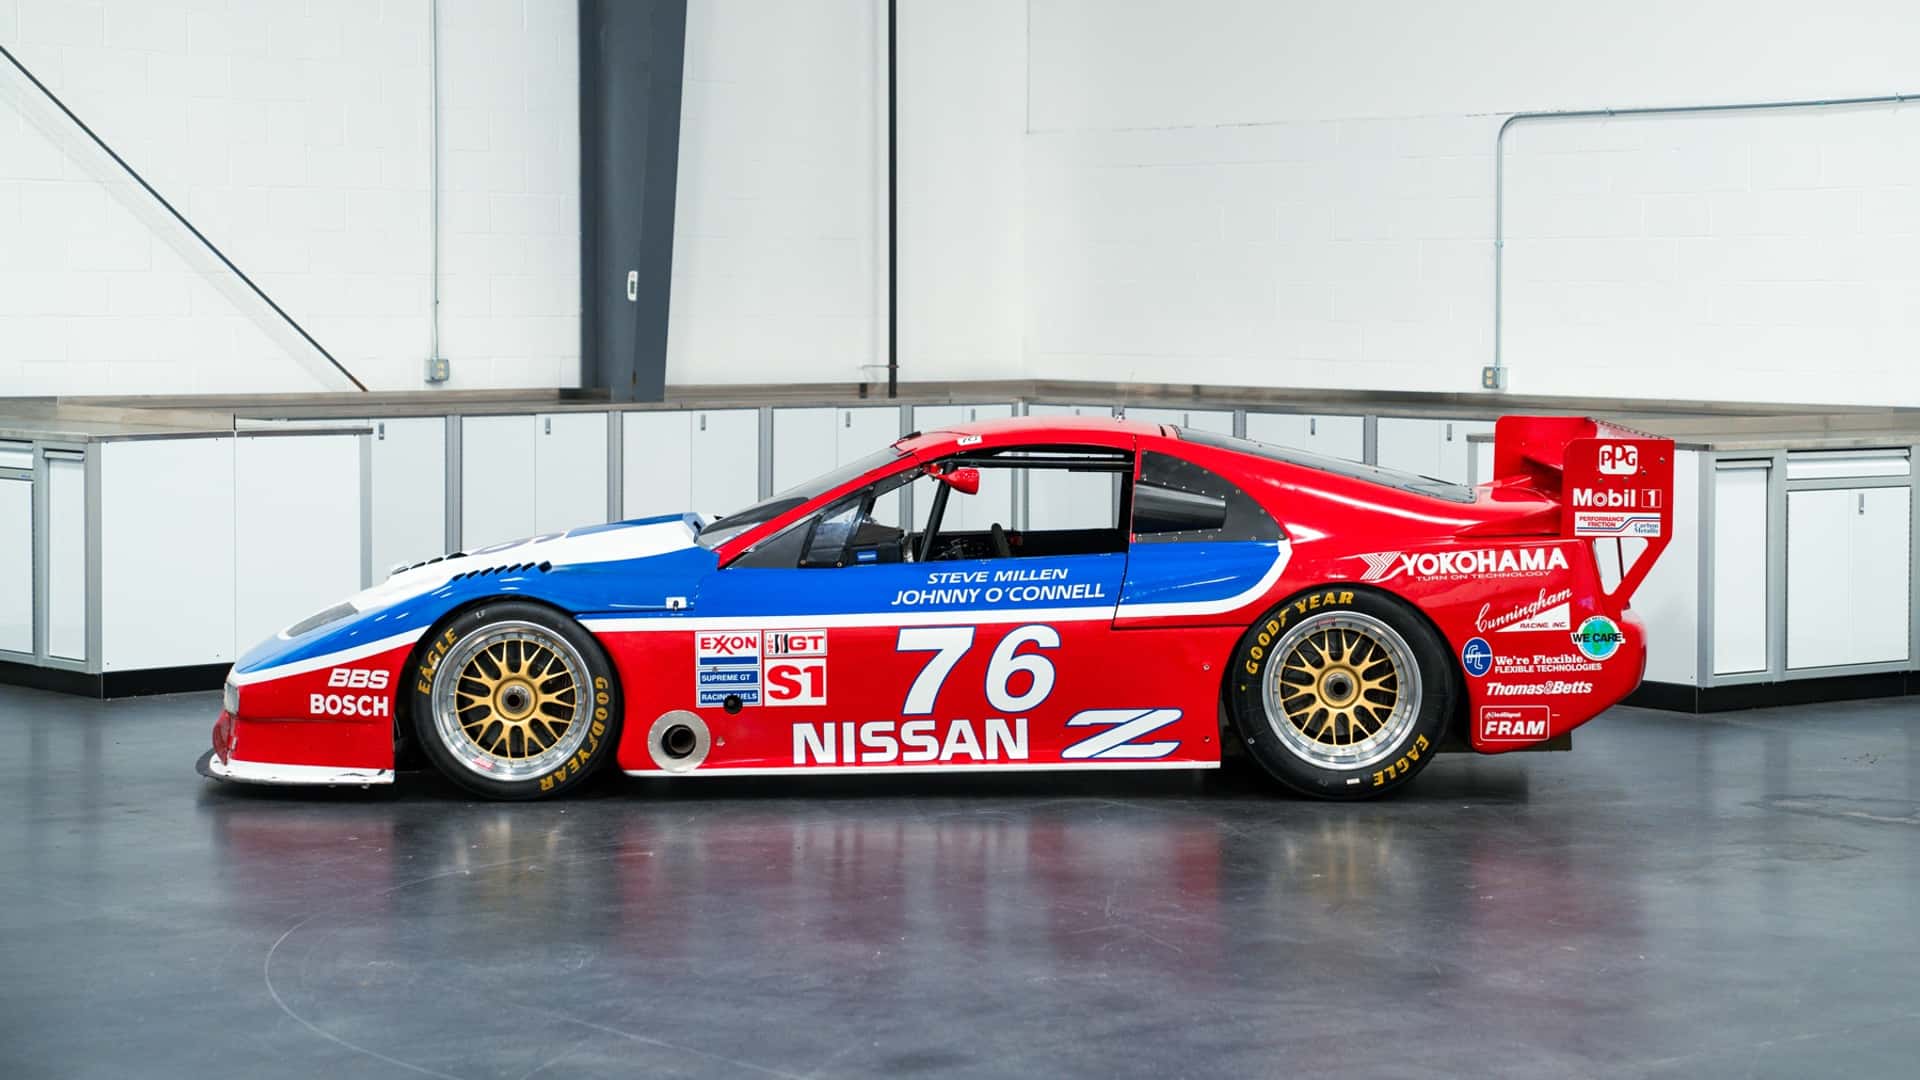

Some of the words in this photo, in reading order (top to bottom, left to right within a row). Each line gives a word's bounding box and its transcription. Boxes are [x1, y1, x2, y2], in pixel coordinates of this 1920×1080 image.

[1600, 446, 1636, 469] PPG
[1572, 488, 1636, 507] Mobil
[1647, 490, 1656, 507] 1
[1400, 547, 1569, 576] YOKOHAMA
[928, 571, 989, 585] STEVE
[994, 568, 1068, 582] MILLEN
[1471, 570, 1551, 579] TECHNOLOGY
[891, 588, 980, 606] JOHNNY
[985, 583, 1105, 603] O'CONNELL
[1475, 588, 1573, 633] Cunningham
[700, 635, 757, 655] EXXON
[788, 635, 825, 651] GT
[1572, 633, 1592, 643] WE
[417, 627, 458, 695] EAGLE
[896, 624, 1062, 716] 76
[1494, 665, 1534, 674] FLEXIBLE
[1537, 663, 1602, 673] TECHNOLOGIES
[1495, 655, 1529, 666] We're
[328, 668, 390, 690] BBS
[702, 673, 737, 682] SUPREME
[739, 673, 751, 681] GT
[767, 665, 824, 699] S1
[1486, 680, 1593, 696] Thomas&Betts
[310, 694, 389, 717] BOSCH
[1485, 720, 1545, 735] FRAM
[793, 718, 1029, 764] NISSAN
[1372, 734, 1430, 787] EAGLE
